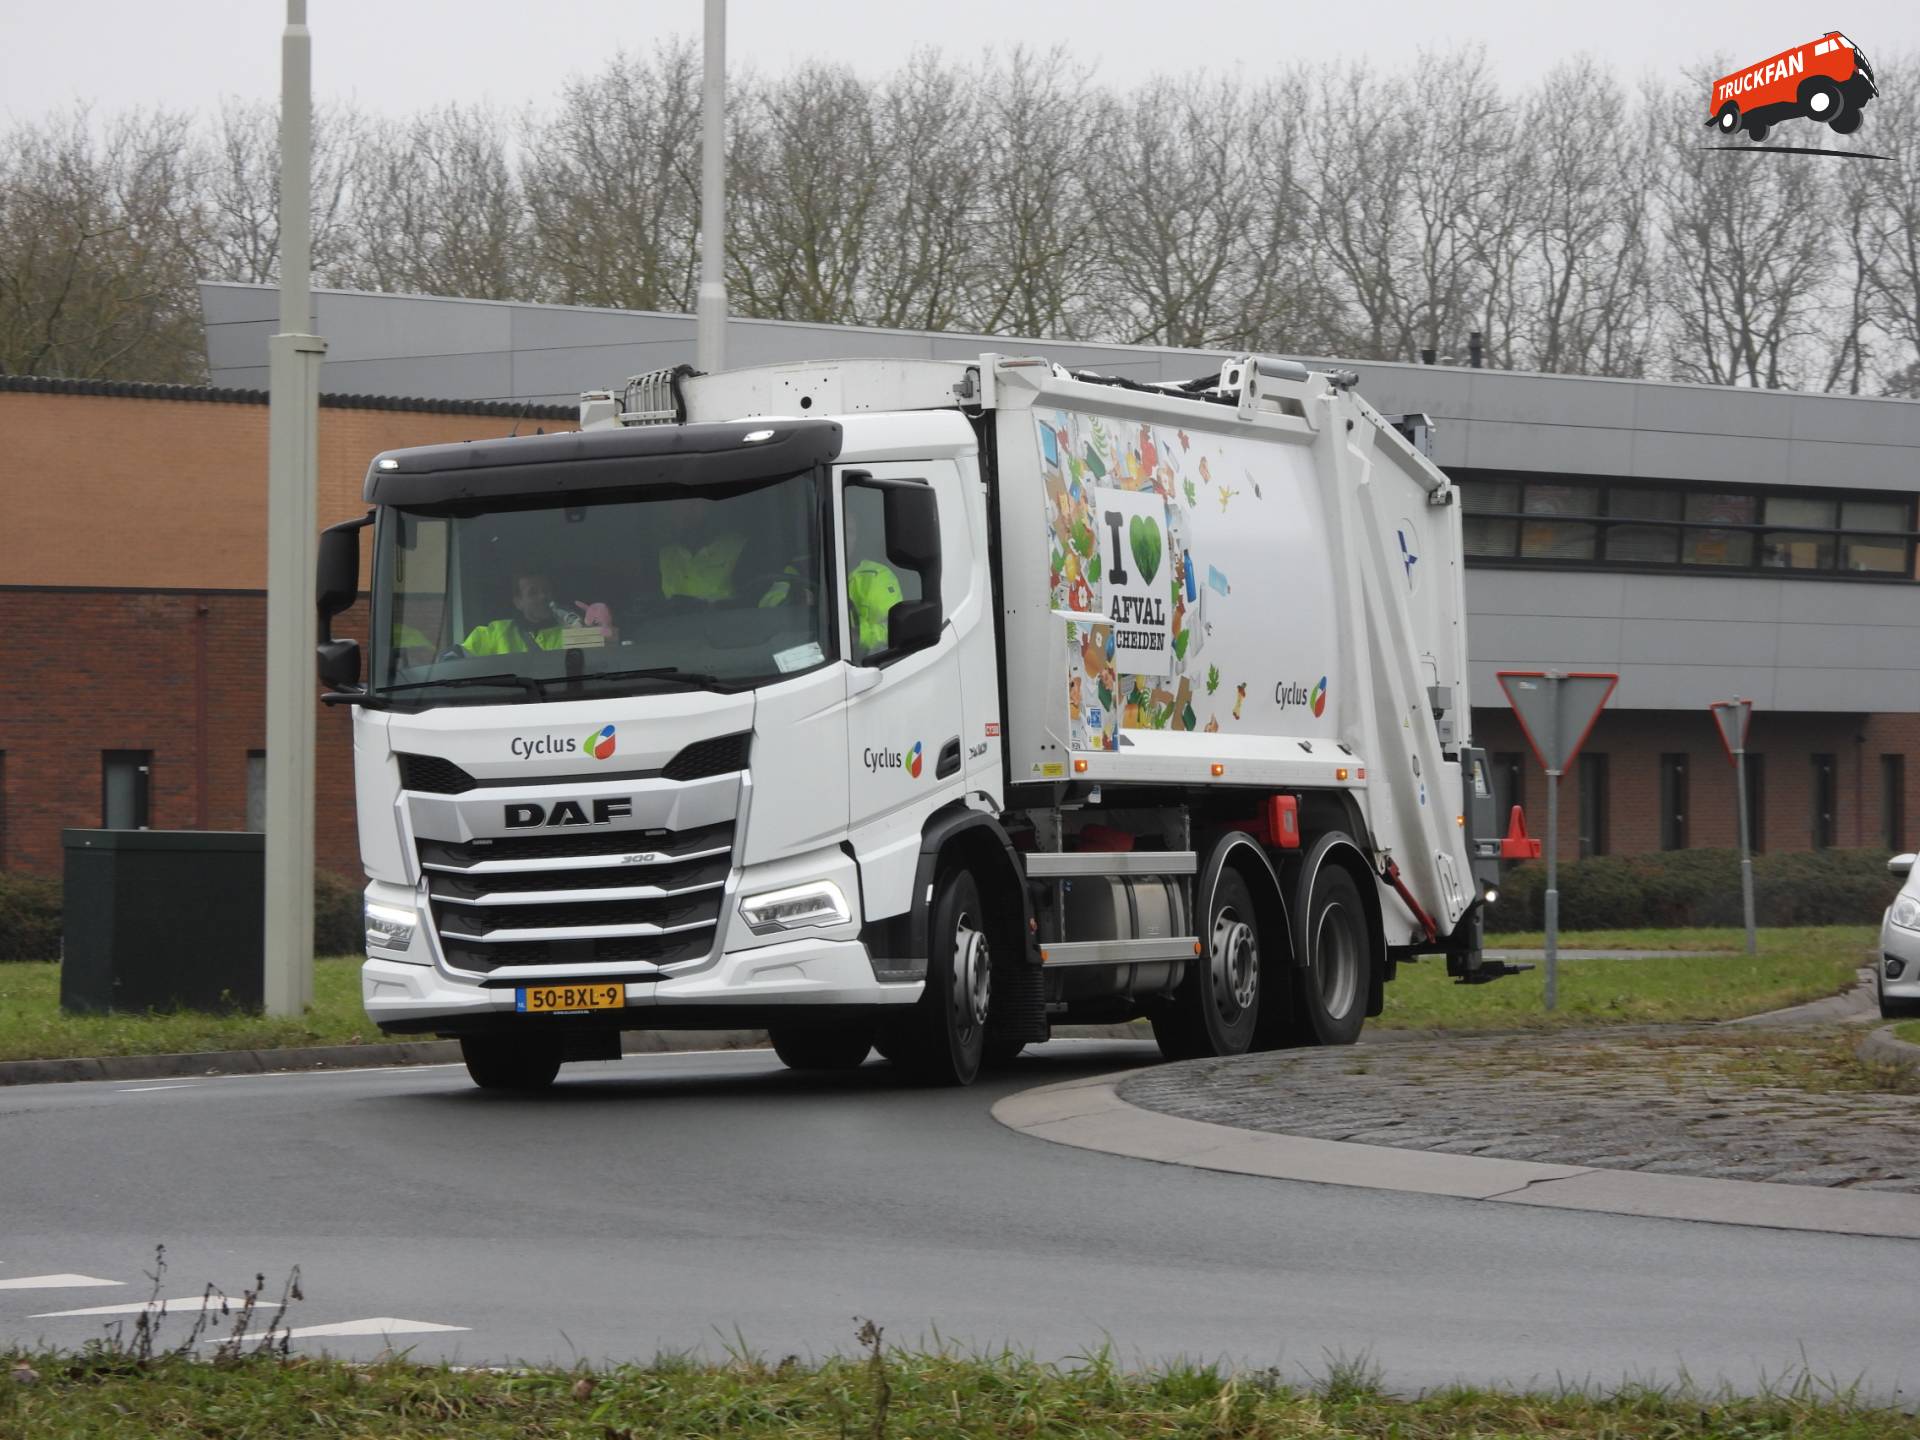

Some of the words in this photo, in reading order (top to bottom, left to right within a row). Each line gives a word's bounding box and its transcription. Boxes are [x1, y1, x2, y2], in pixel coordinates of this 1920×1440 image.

[1104, 510, 1128, 586] I
[1110, 594, 1166, 626] AFVAL
[1115, 629, 1166, 652] CHEIDEN
[1275, 680, 1308, 711] Cyclus
[511, 734, 576, 760] Cyclus
[863, 746, 902, 773] Cyclus
[504, 797, 632, 830] DAF
[620, 853, 656, 865] 300
[533, 987, 618, 1009] 50-BXL-9
